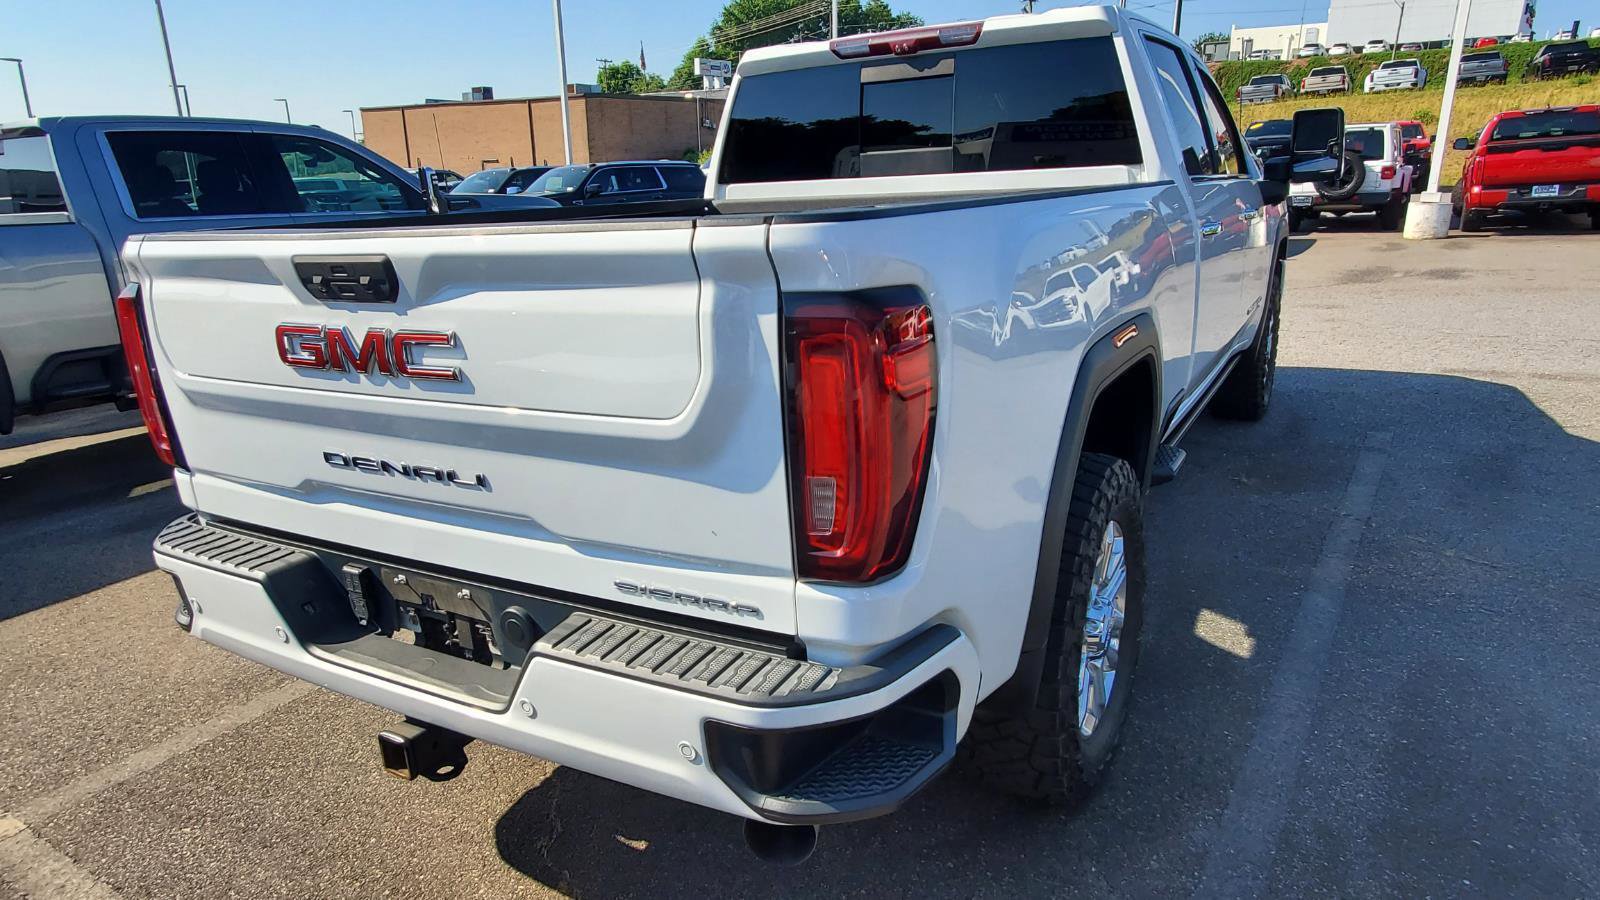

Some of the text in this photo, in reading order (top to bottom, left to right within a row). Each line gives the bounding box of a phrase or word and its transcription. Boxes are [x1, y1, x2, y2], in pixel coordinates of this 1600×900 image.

[275, 322, 462, 381] GMC
[322, 451, 488, 489] DENALI
[614, 580, 761, 616] SIERRA
